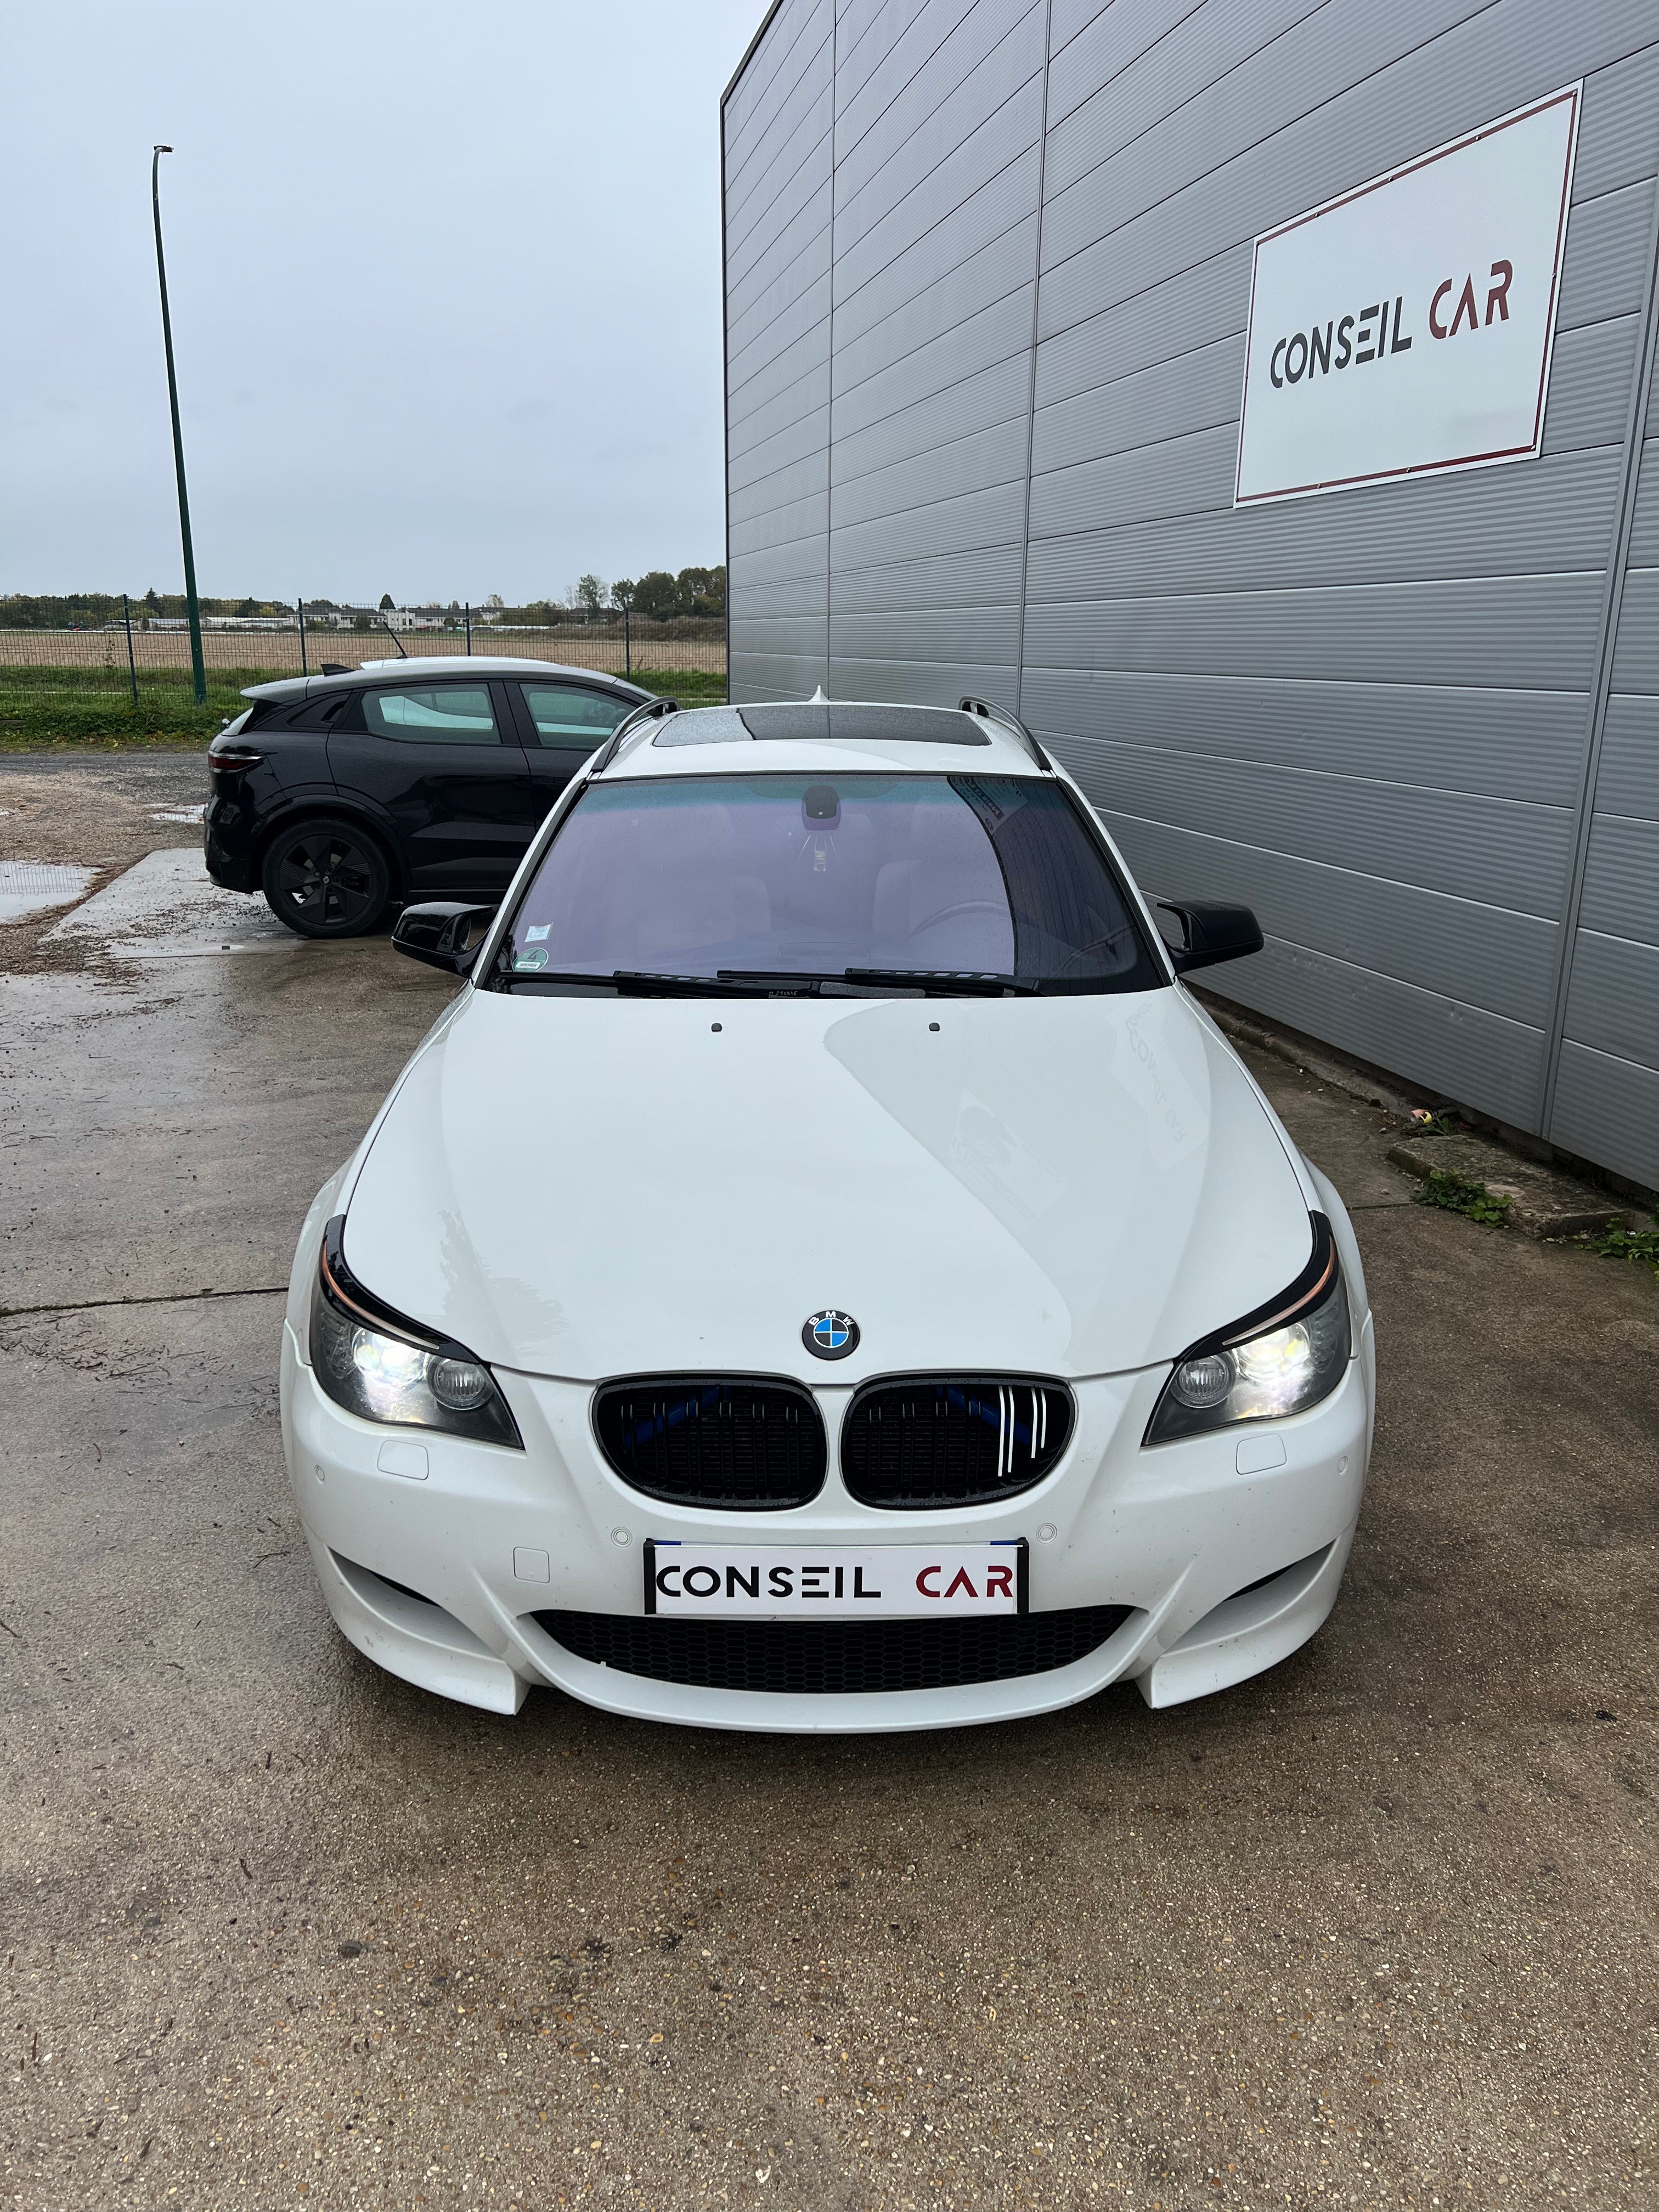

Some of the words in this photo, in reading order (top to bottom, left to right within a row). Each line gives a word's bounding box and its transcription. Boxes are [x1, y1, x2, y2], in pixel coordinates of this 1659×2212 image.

[1270, 296, 1412, 388] CONSEIL
[1429, 259, 1513, 340] CAR
[527, 950, 539, 961] 4
[808, 1311, 855, 1326] BMW
[656, 1565, 882, 1599] CONSEIL
[916, 1566, 1013, 1598] CAR
